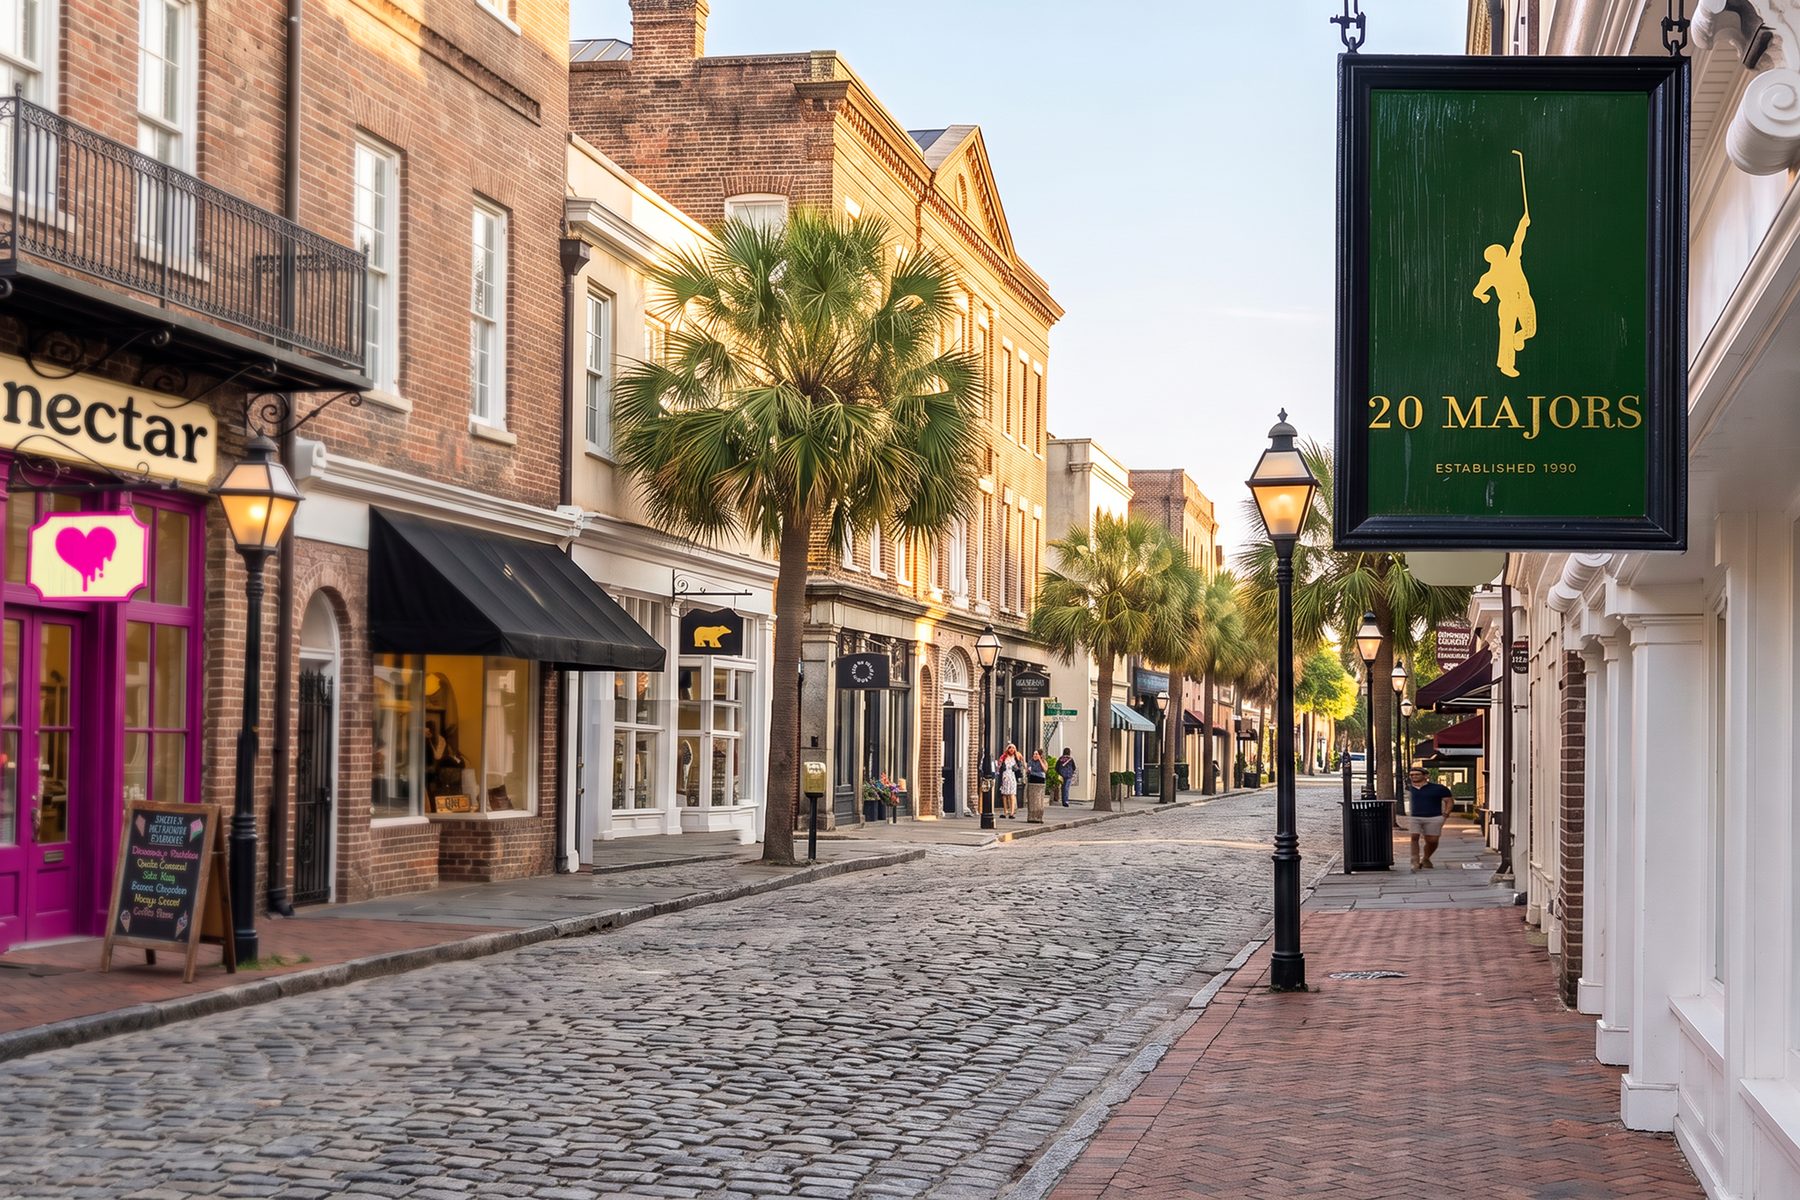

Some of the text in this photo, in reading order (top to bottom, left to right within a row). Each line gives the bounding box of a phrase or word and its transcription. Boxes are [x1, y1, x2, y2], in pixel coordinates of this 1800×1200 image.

[3, 381, 208, 463] nectar
[1368, 395, 1642, 440] 20 MAJORS
[1435, 463, 1577, 473] ESTABLISHED 1990
